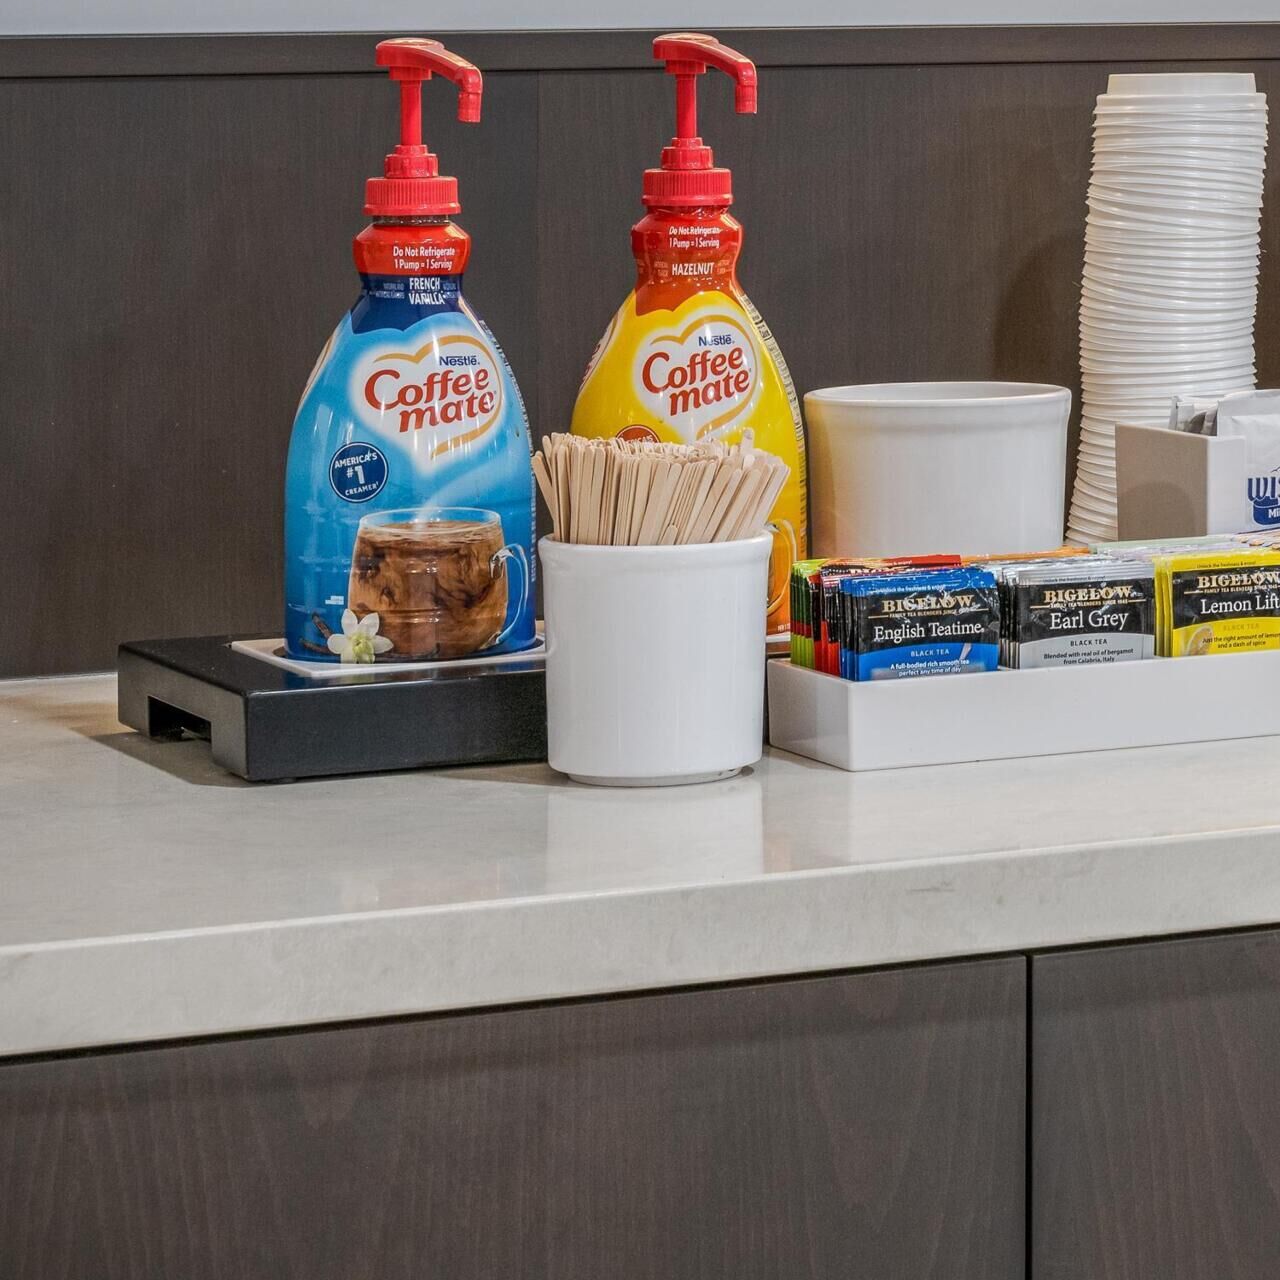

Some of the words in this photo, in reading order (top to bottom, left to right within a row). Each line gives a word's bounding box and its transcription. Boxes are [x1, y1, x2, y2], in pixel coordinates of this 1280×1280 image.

[393, 246, 403, 257] Do
[405, 246, 418, 257] Not
[419, 246, 455, 259] Refrigerate
[399, 259, 419, 271] Pump
[430, 259, 453, 271] Serving
[672, 262, 715, 276] HAZELNUT
[409, 277, 441, 290] FRENCH
[439, 355, 477, 366] Nestlé
[642, 347, 743, 394] Coffee
[364, 368, 489, 411] Coffee
[669, 369, 750, 417] mate
[399, 391, 494, 433] mate
[346, 465, 365, 485] #1
[1197, 571, 1280, 589] BIGELOW
[882, 594, 973, 613] BIGELOW
[1044, 586, 1133, 603] BIGELOW
[1200, 598, 1251, 614] Lemon
[1255, 592, 1280, 611] Lift
[1050, 609, 1084, 629] Earl
[1088, 609, 1129, 630] Grey
[874, 623, 925, 644] English
[928, 621, 982, 637] Teatime
[1107, 648, 1134, 656] bergamot
[898, 669, 919, 677] perfect
